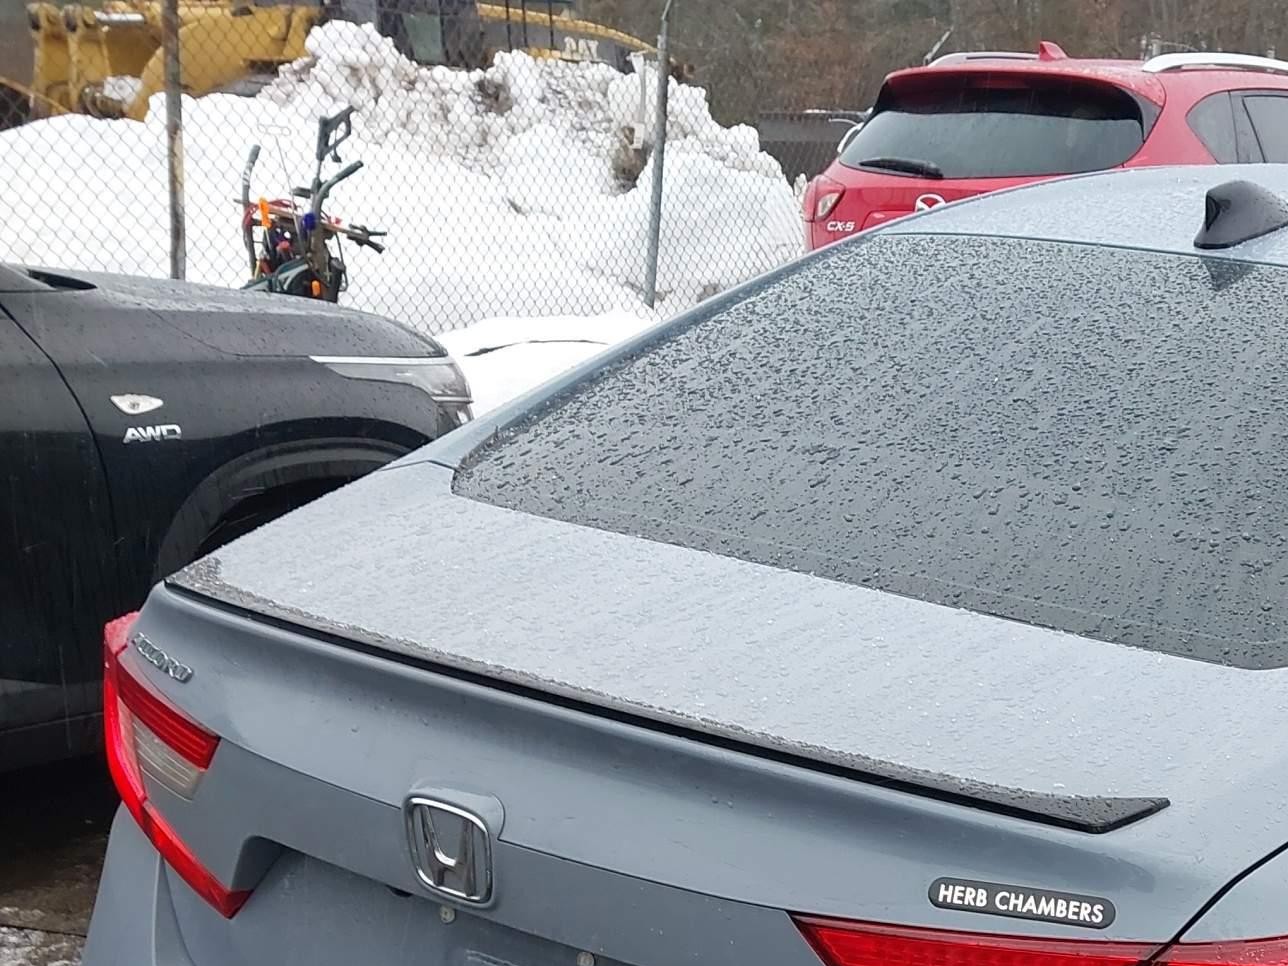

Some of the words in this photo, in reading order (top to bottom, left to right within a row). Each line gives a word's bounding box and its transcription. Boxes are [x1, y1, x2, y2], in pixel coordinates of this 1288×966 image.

[826, 221, 856, 232] CX-5
[122, 423, 182, 443] AWD
[937, 883, 988, 907] HERB
[994, 891, 1104, 923] CHAMBERS
